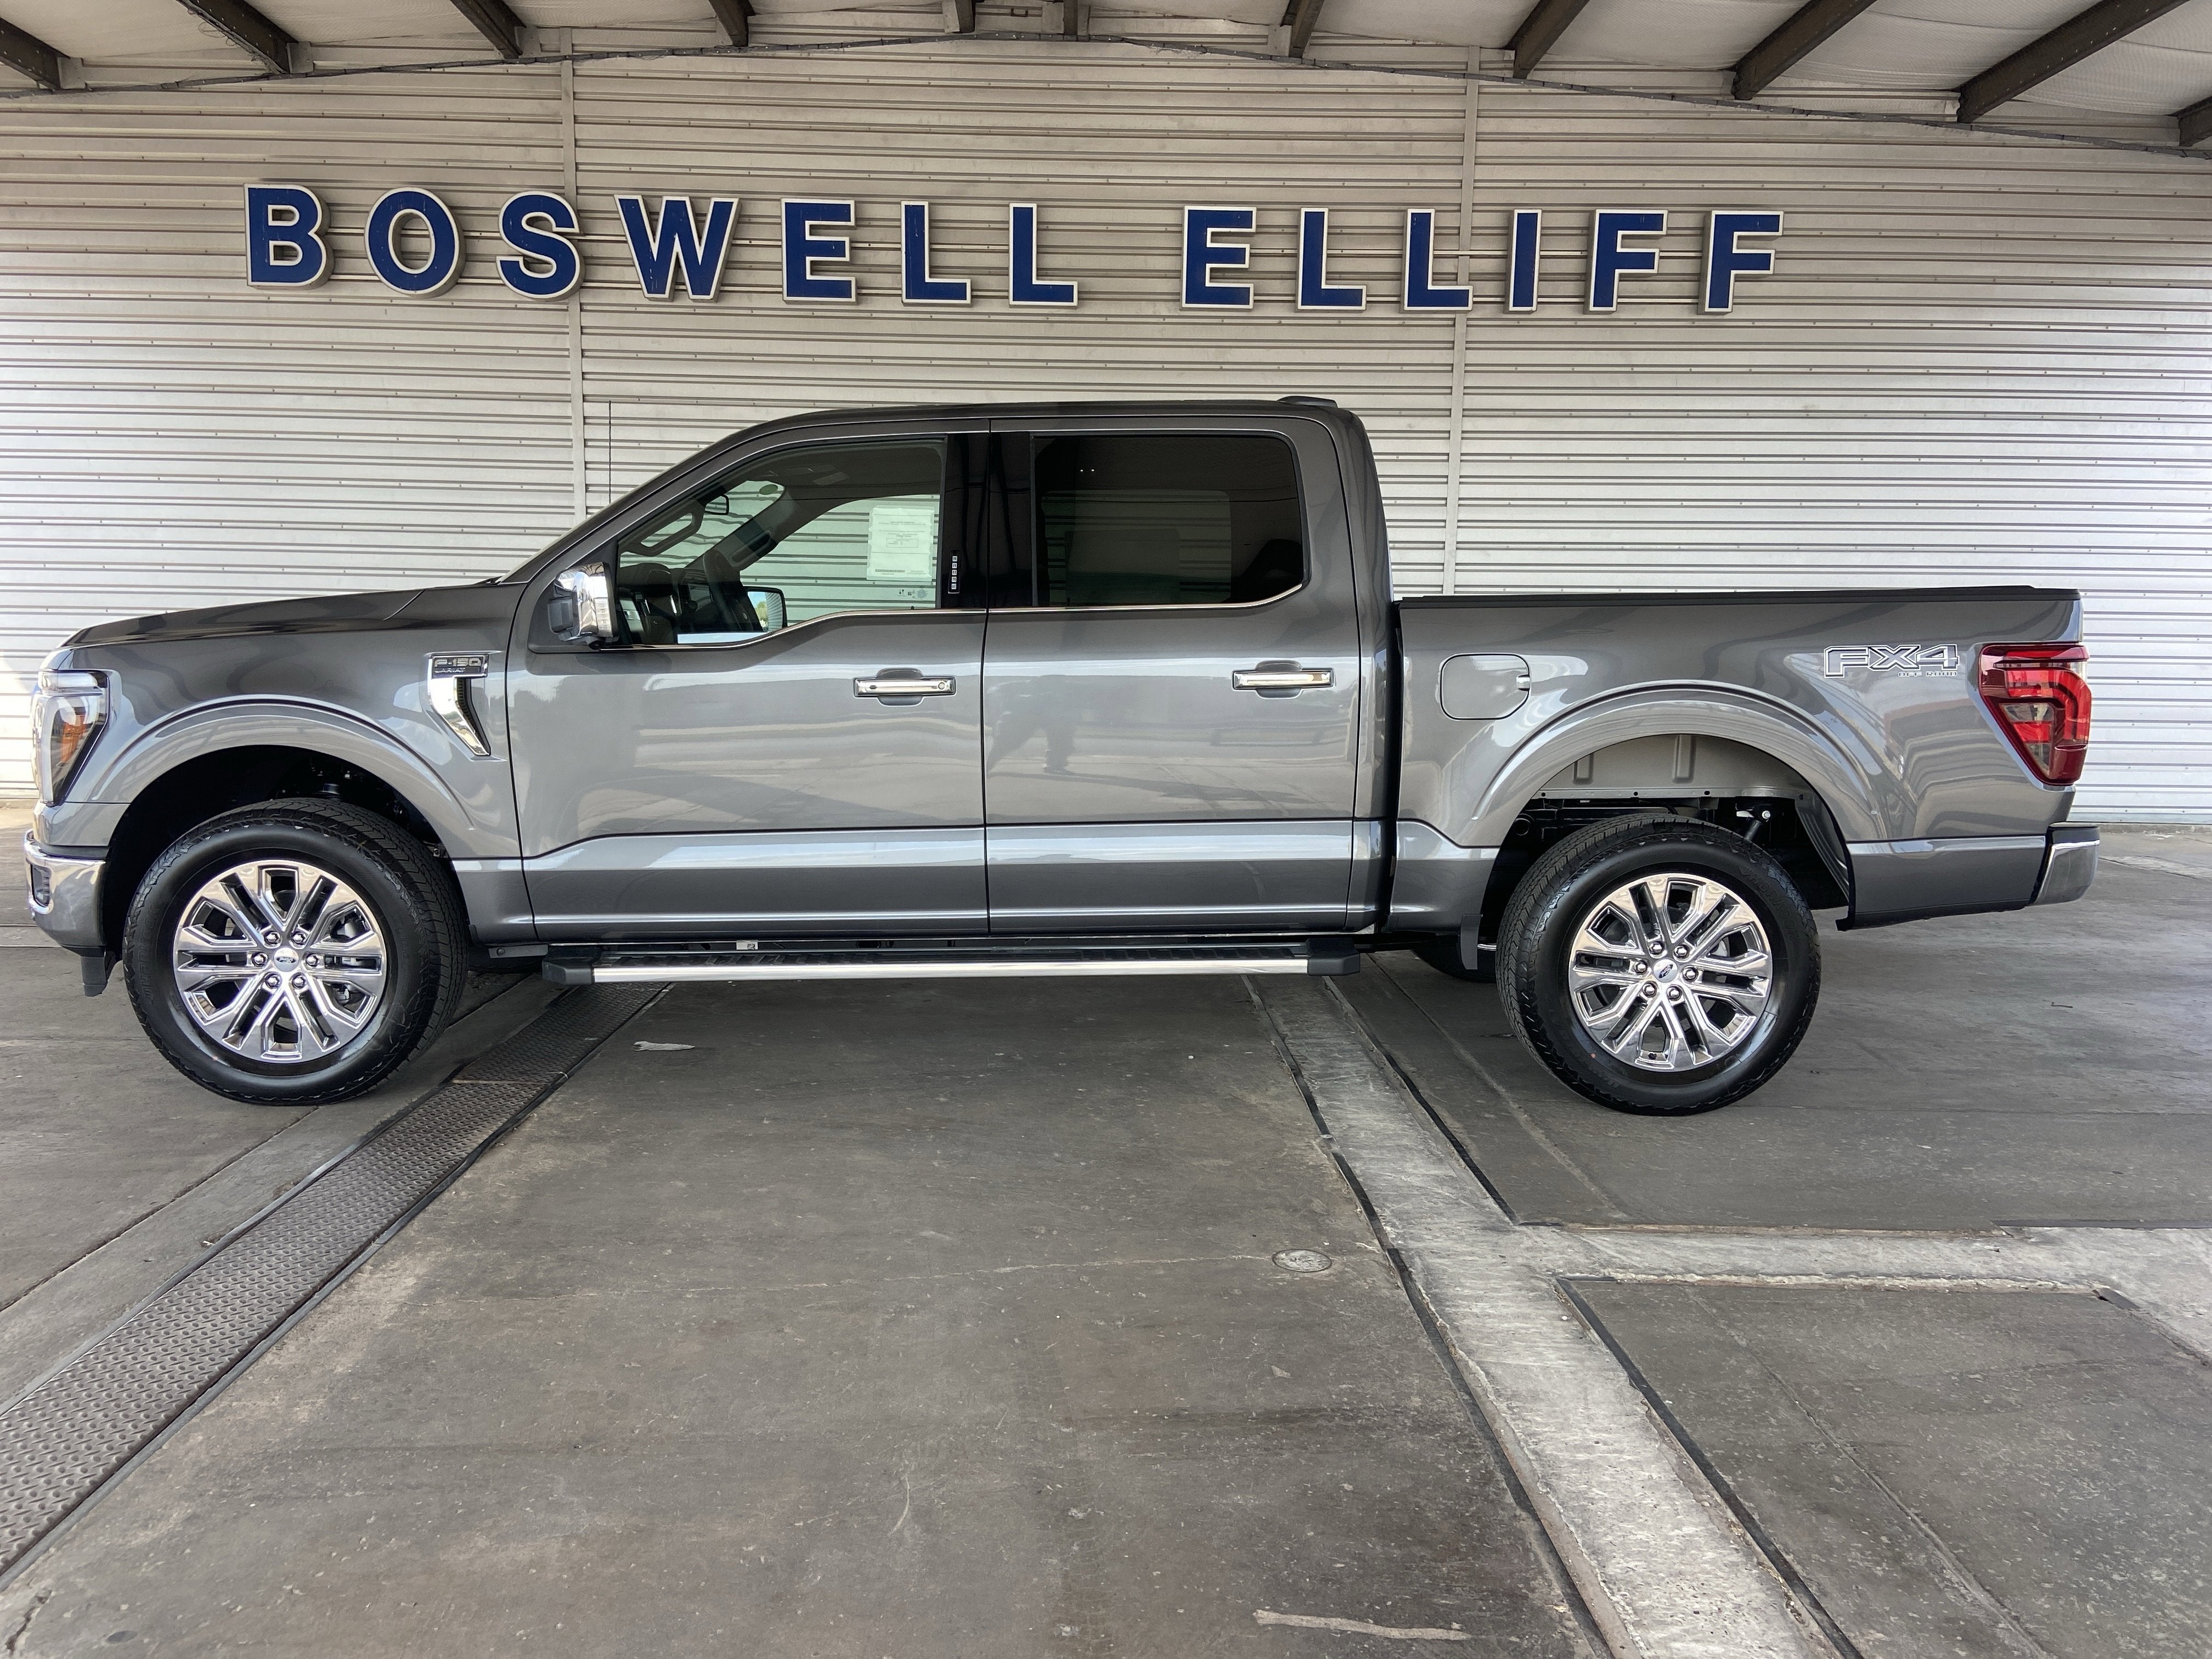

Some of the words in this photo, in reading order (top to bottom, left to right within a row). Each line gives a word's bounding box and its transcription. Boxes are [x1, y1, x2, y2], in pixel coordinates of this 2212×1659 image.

[244, 184, 1078, 307] BOSWELL
[1181, 206, 1784, 314] ELLIFF
[435, 658, 481, 667] F-150
[1824, 644, 1959, 678] FX4
